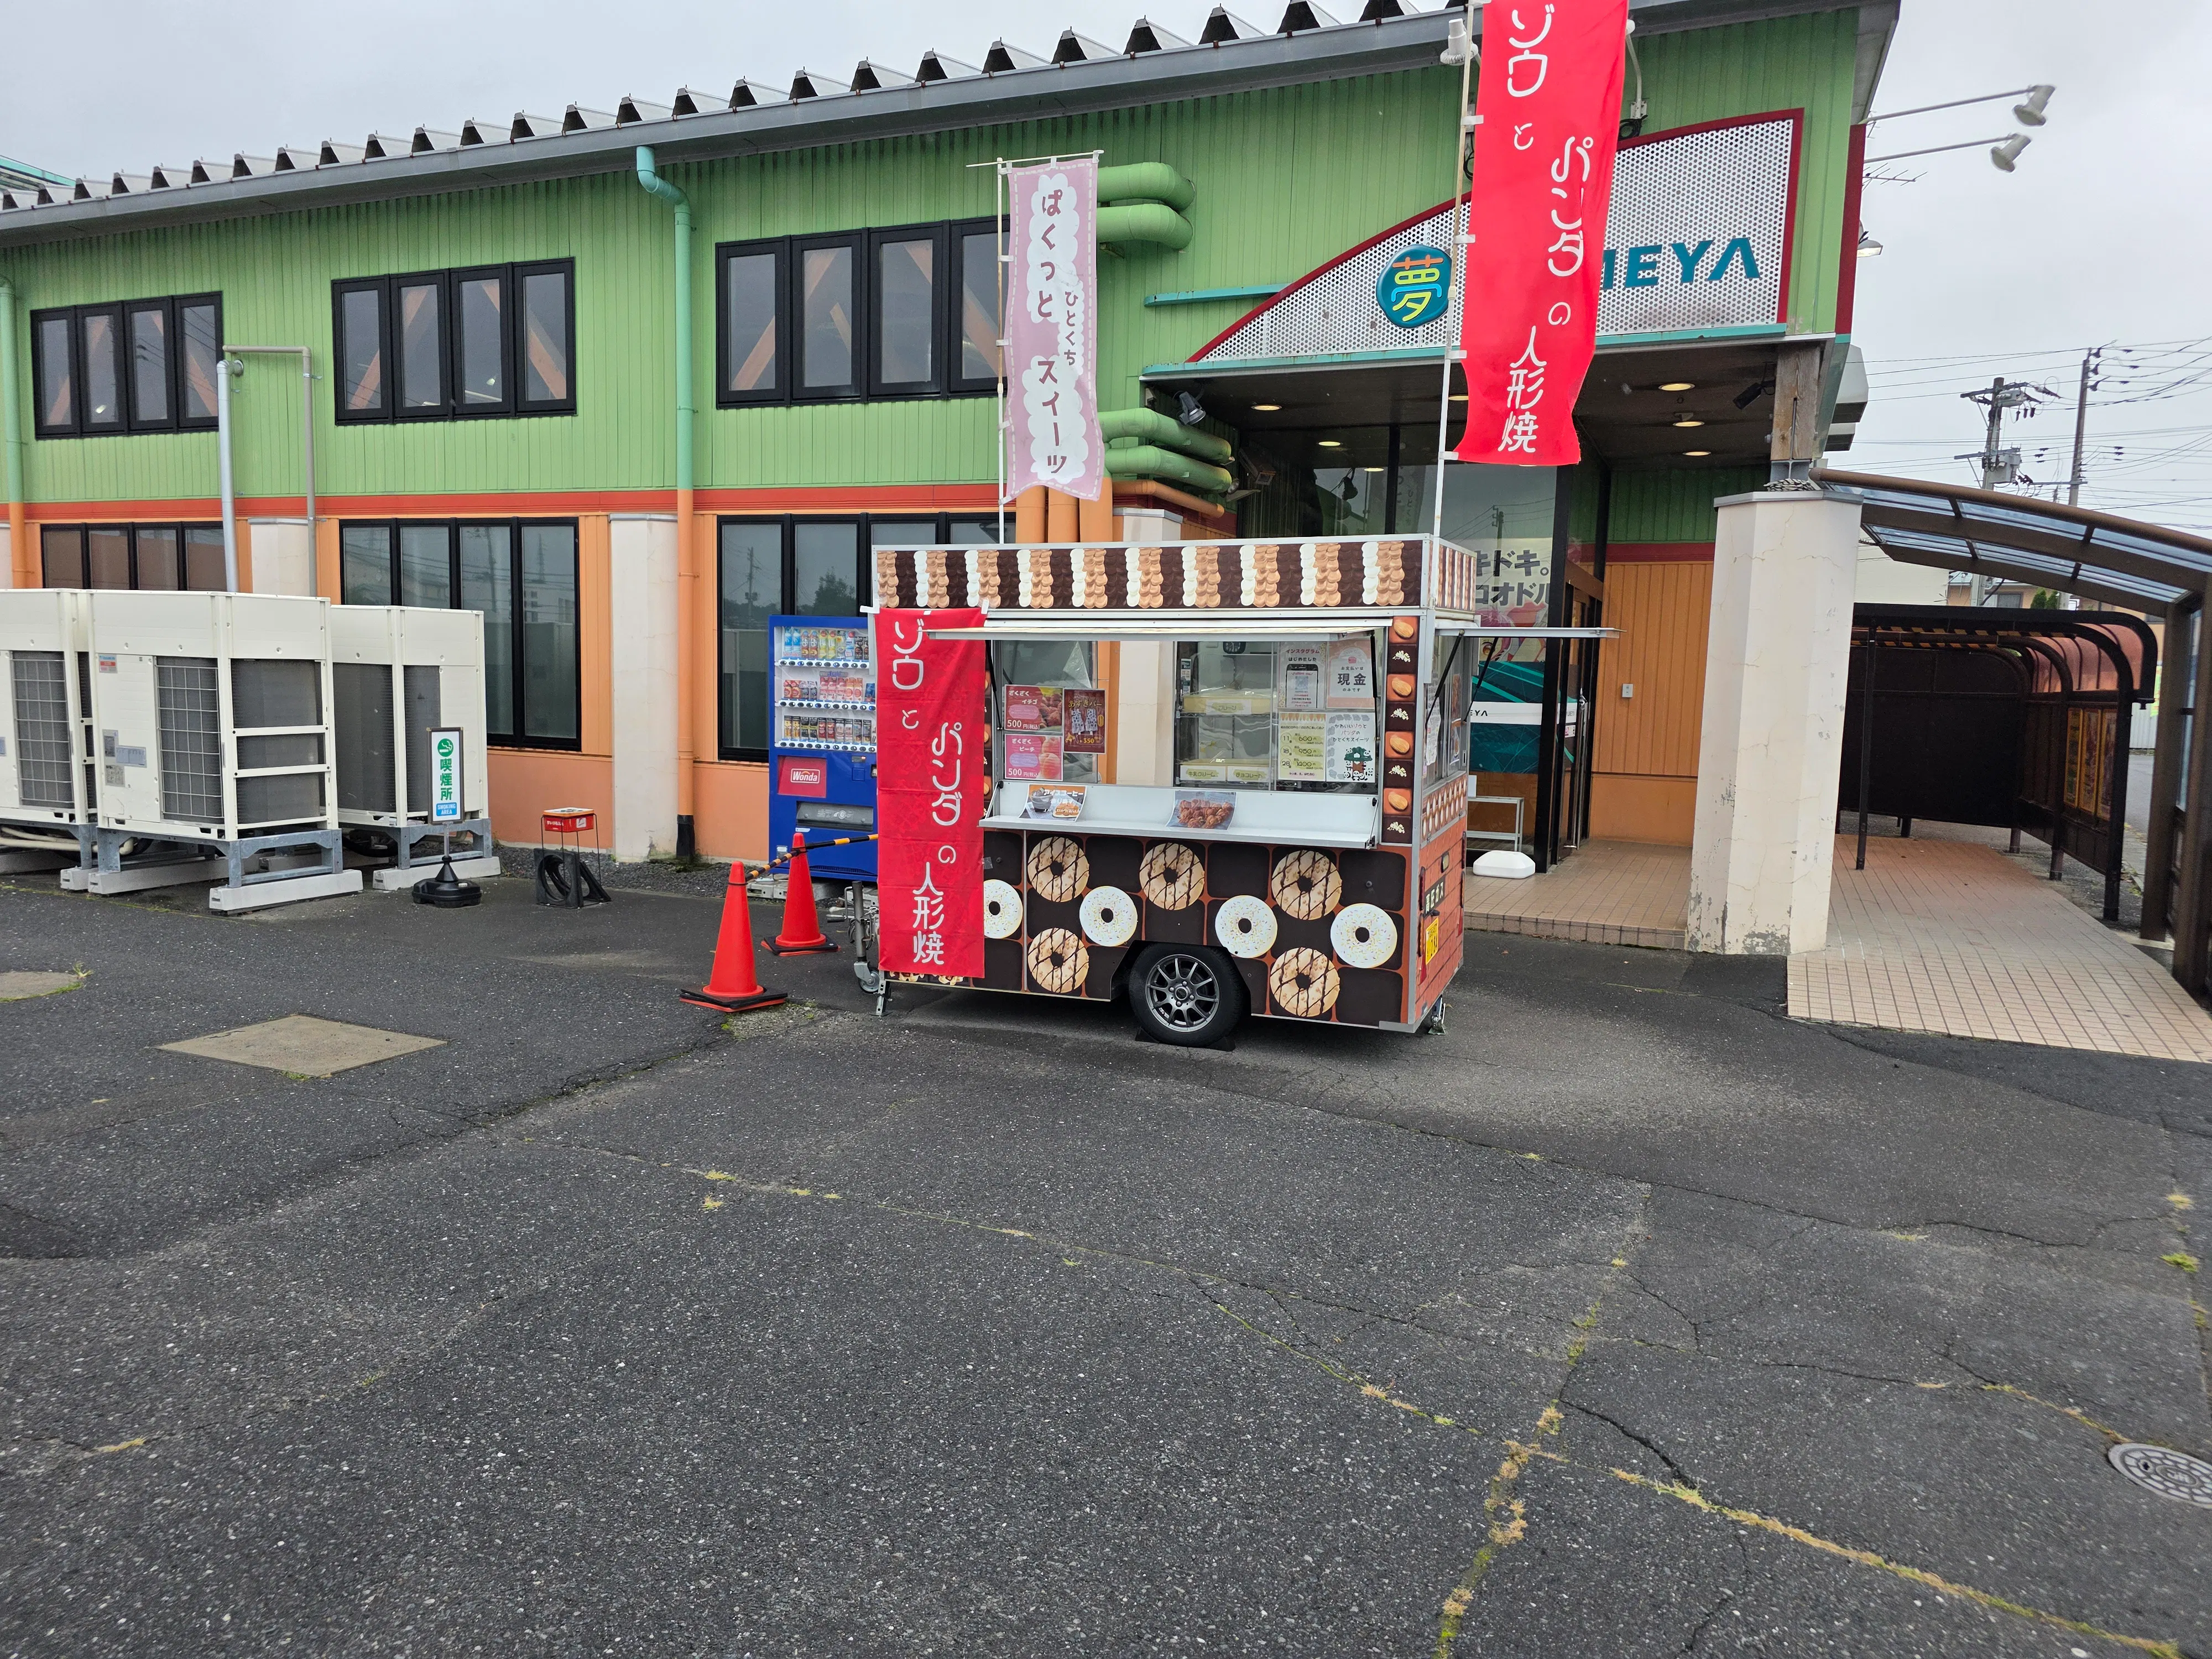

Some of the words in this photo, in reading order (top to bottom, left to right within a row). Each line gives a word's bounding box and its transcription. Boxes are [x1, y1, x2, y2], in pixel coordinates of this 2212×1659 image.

[1037, 189, 1063, 319] ぱくっと
[1390, 256, 1444, 324] 夢
[1063, 290, 1079, 367] ひとくち
[1036, 359, 1067, 474] スイーツ
[1498, 325, 1548, 455] 人形焼
[1338, 672, 1366, 686] 現金
[1007, 719, 1022, 728] 500
[440, 758, 453, 801] 喫煙所
[792, 771, 818, 781] Wonda
[912, 862, 945, 965] 人形焼
[1426, 881, 1443, 914] 高圧ガス
